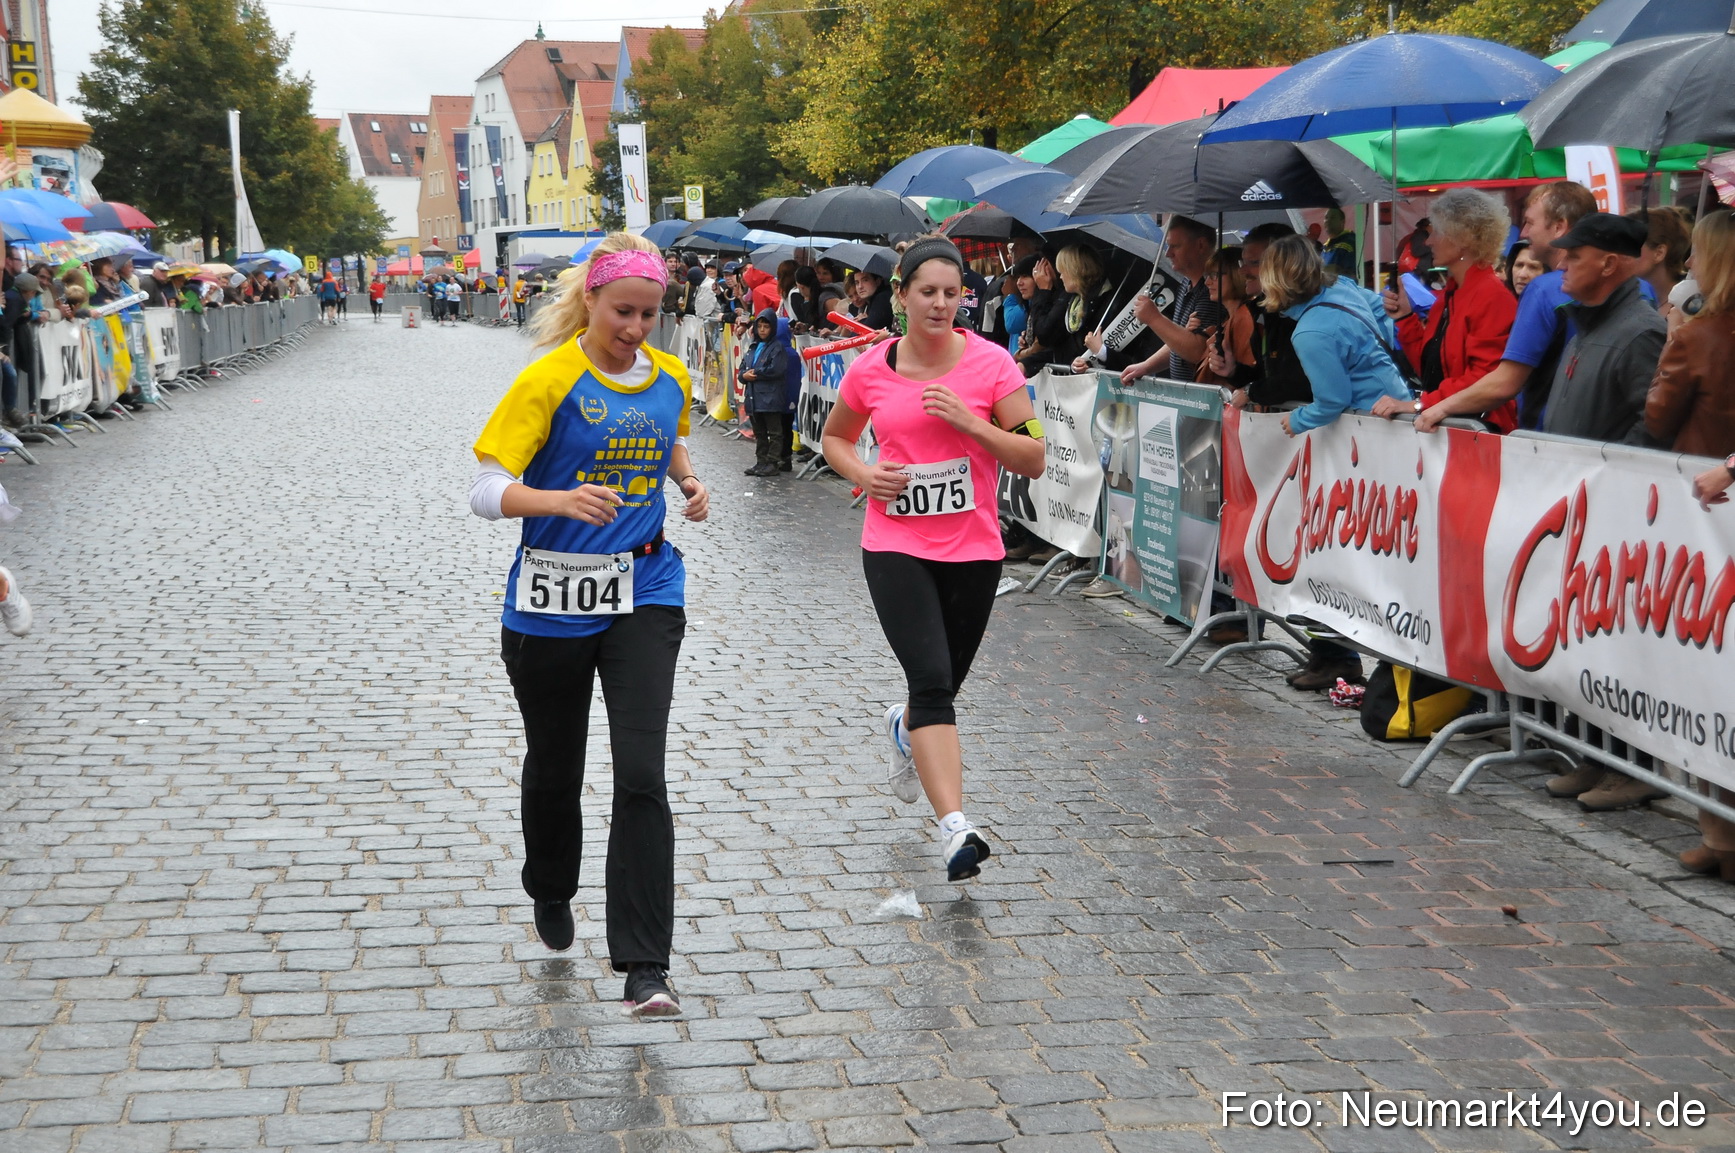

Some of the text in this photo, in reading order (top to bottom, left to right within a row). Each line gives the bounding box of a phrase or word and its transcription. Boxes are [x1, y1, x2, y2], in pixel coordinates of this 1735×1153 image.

[1240, 193, 1283, 201] adidas
[915, 468, 956, 480] Neumarkt
[896, 479, 966, 515] 5075
[1257, 434, 1423, 584] Charivari
[524, 555, 613, 572] PARTL Neumarkt
[530, 573, 622, 612] 5104
[1308, 577, 1431, 647] Ostbayerns Radio
[1579, 668, 1707, 746] Ostbayerns
